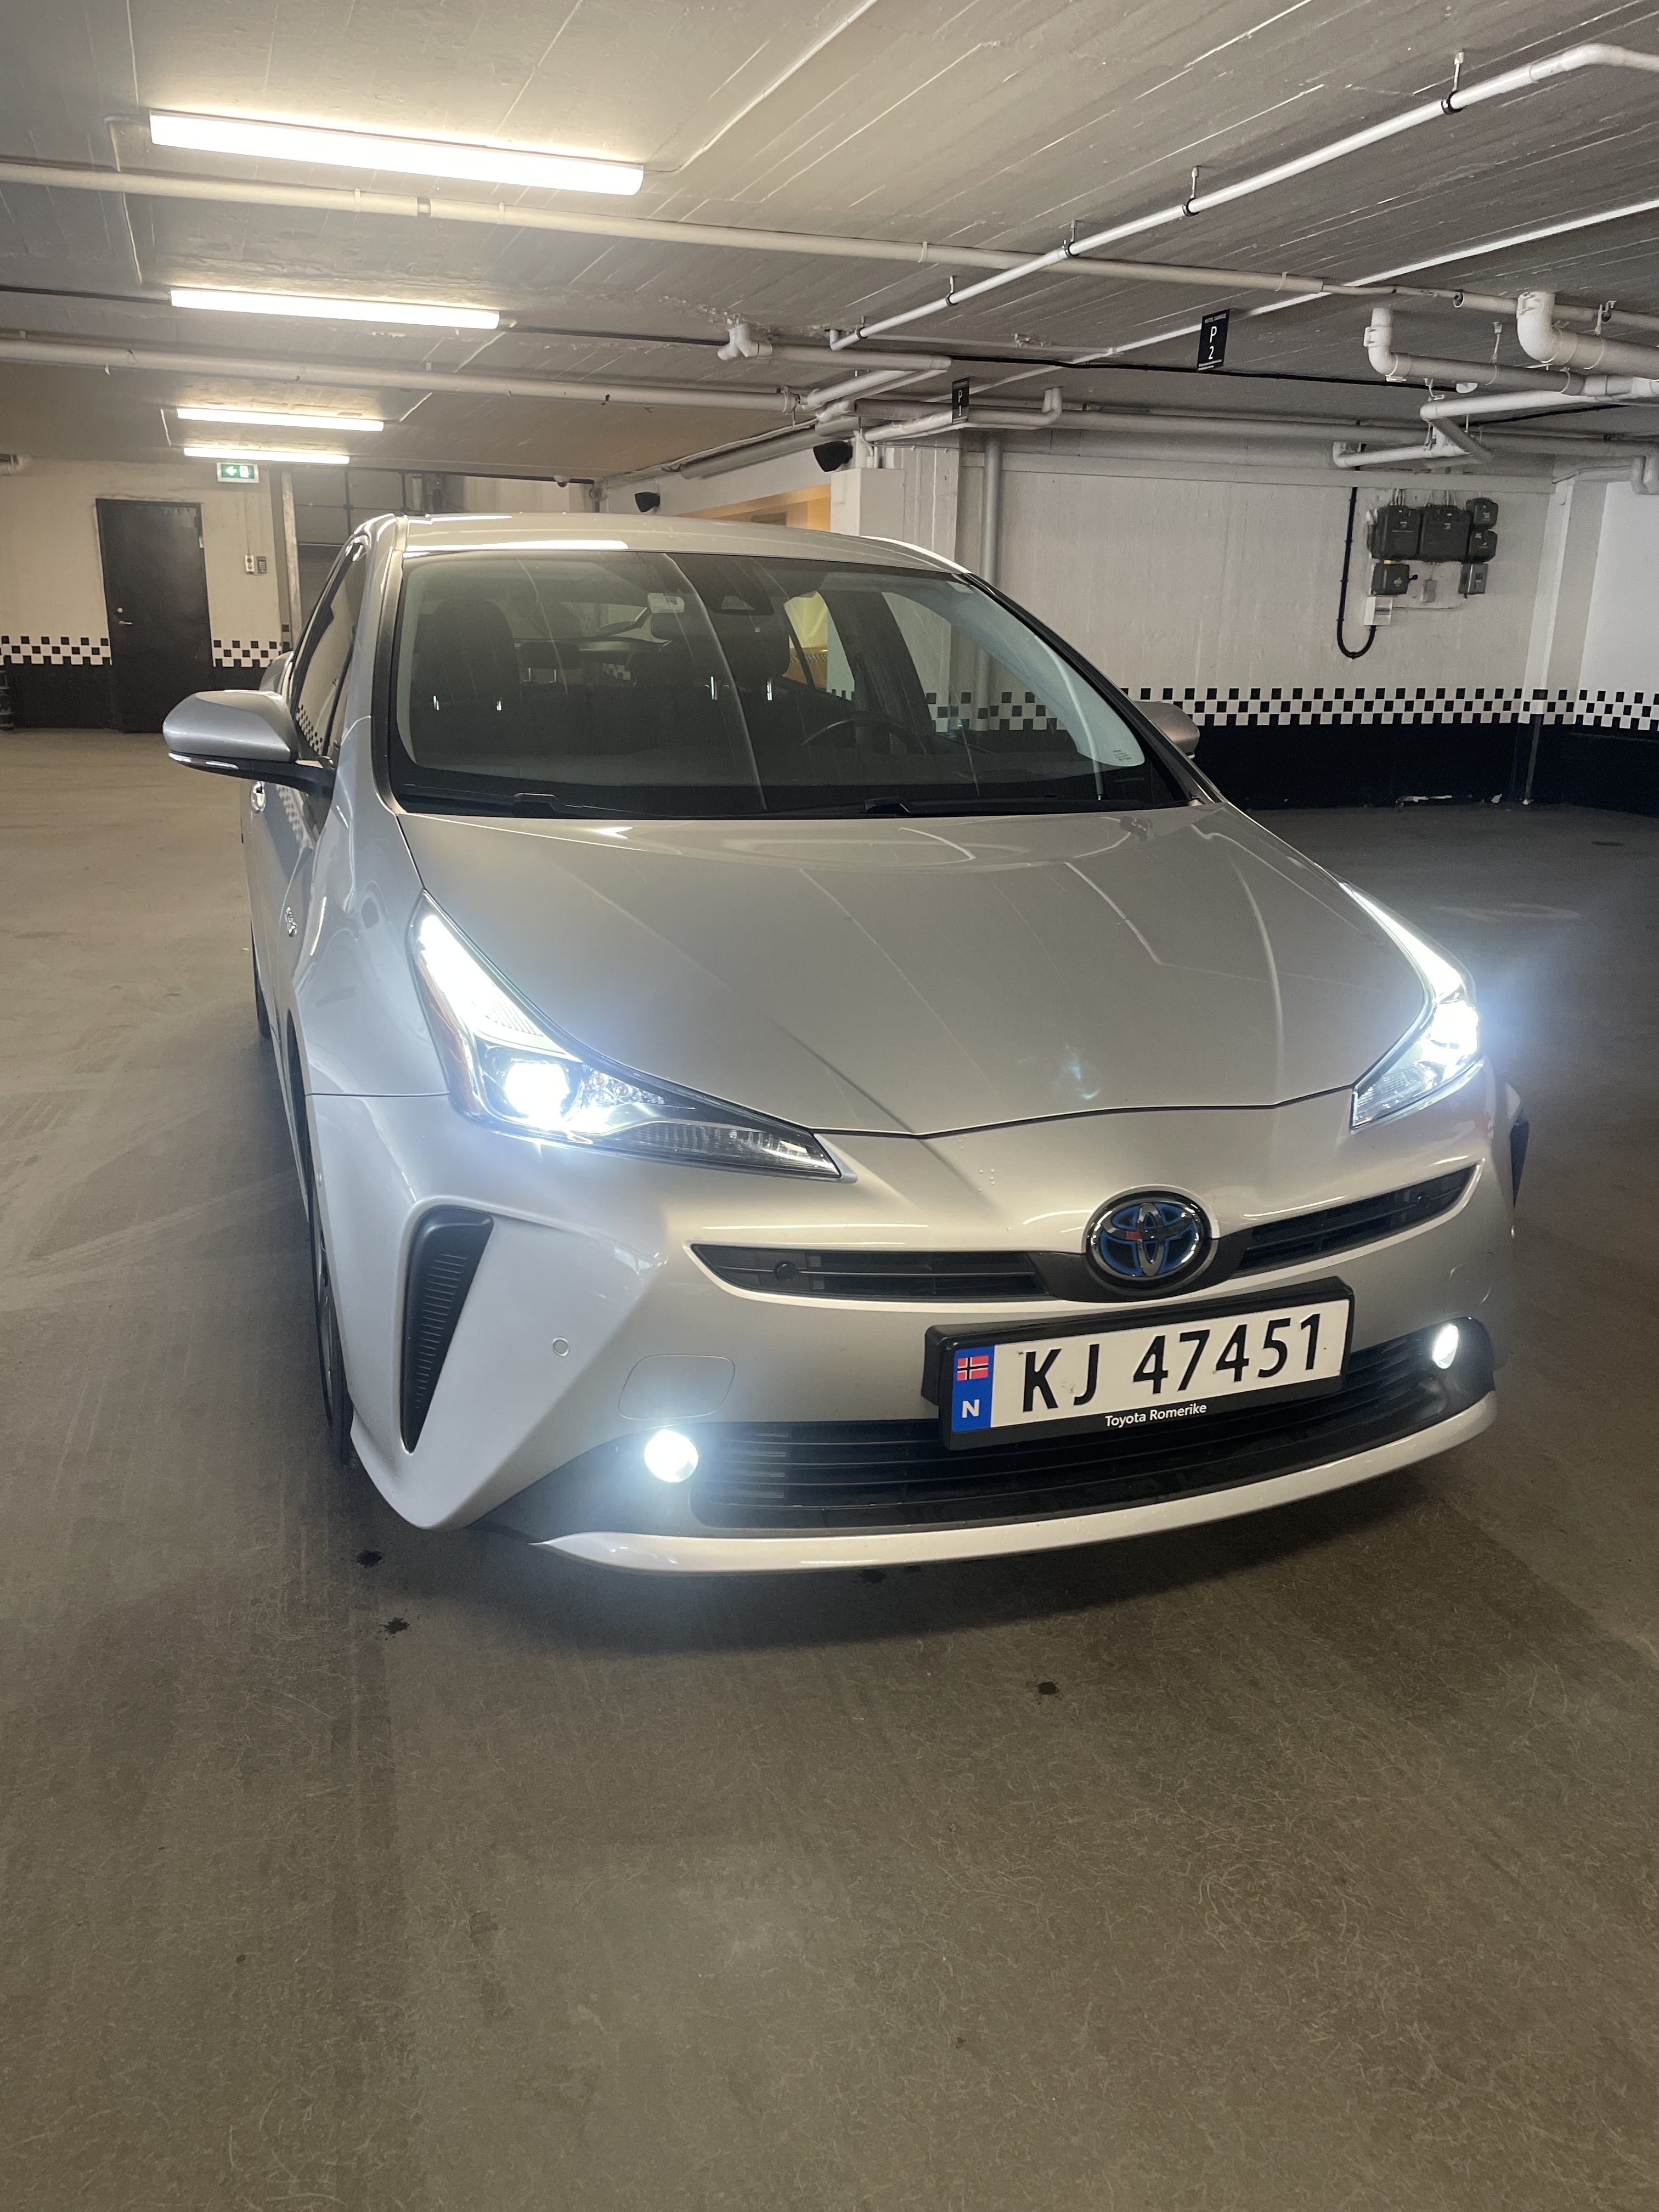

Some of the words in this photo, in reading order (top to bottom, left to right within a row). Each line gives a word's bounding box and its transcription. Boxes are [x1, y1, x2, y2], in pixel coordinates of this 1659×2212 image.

[1210, 326, 1217, 343] P
[1208, 346, 1214, 360] 2
[958, 390, 963, 403] P
[1023, 1344, 1099, 1413] KJ
[1133, 1313, 1321, 1395] 47451
[962, 1399, 980, 1418] N
[1105, 1413, 1147, 1428] Toyota
[1149, 1403, 1207, 1421] Romerike
